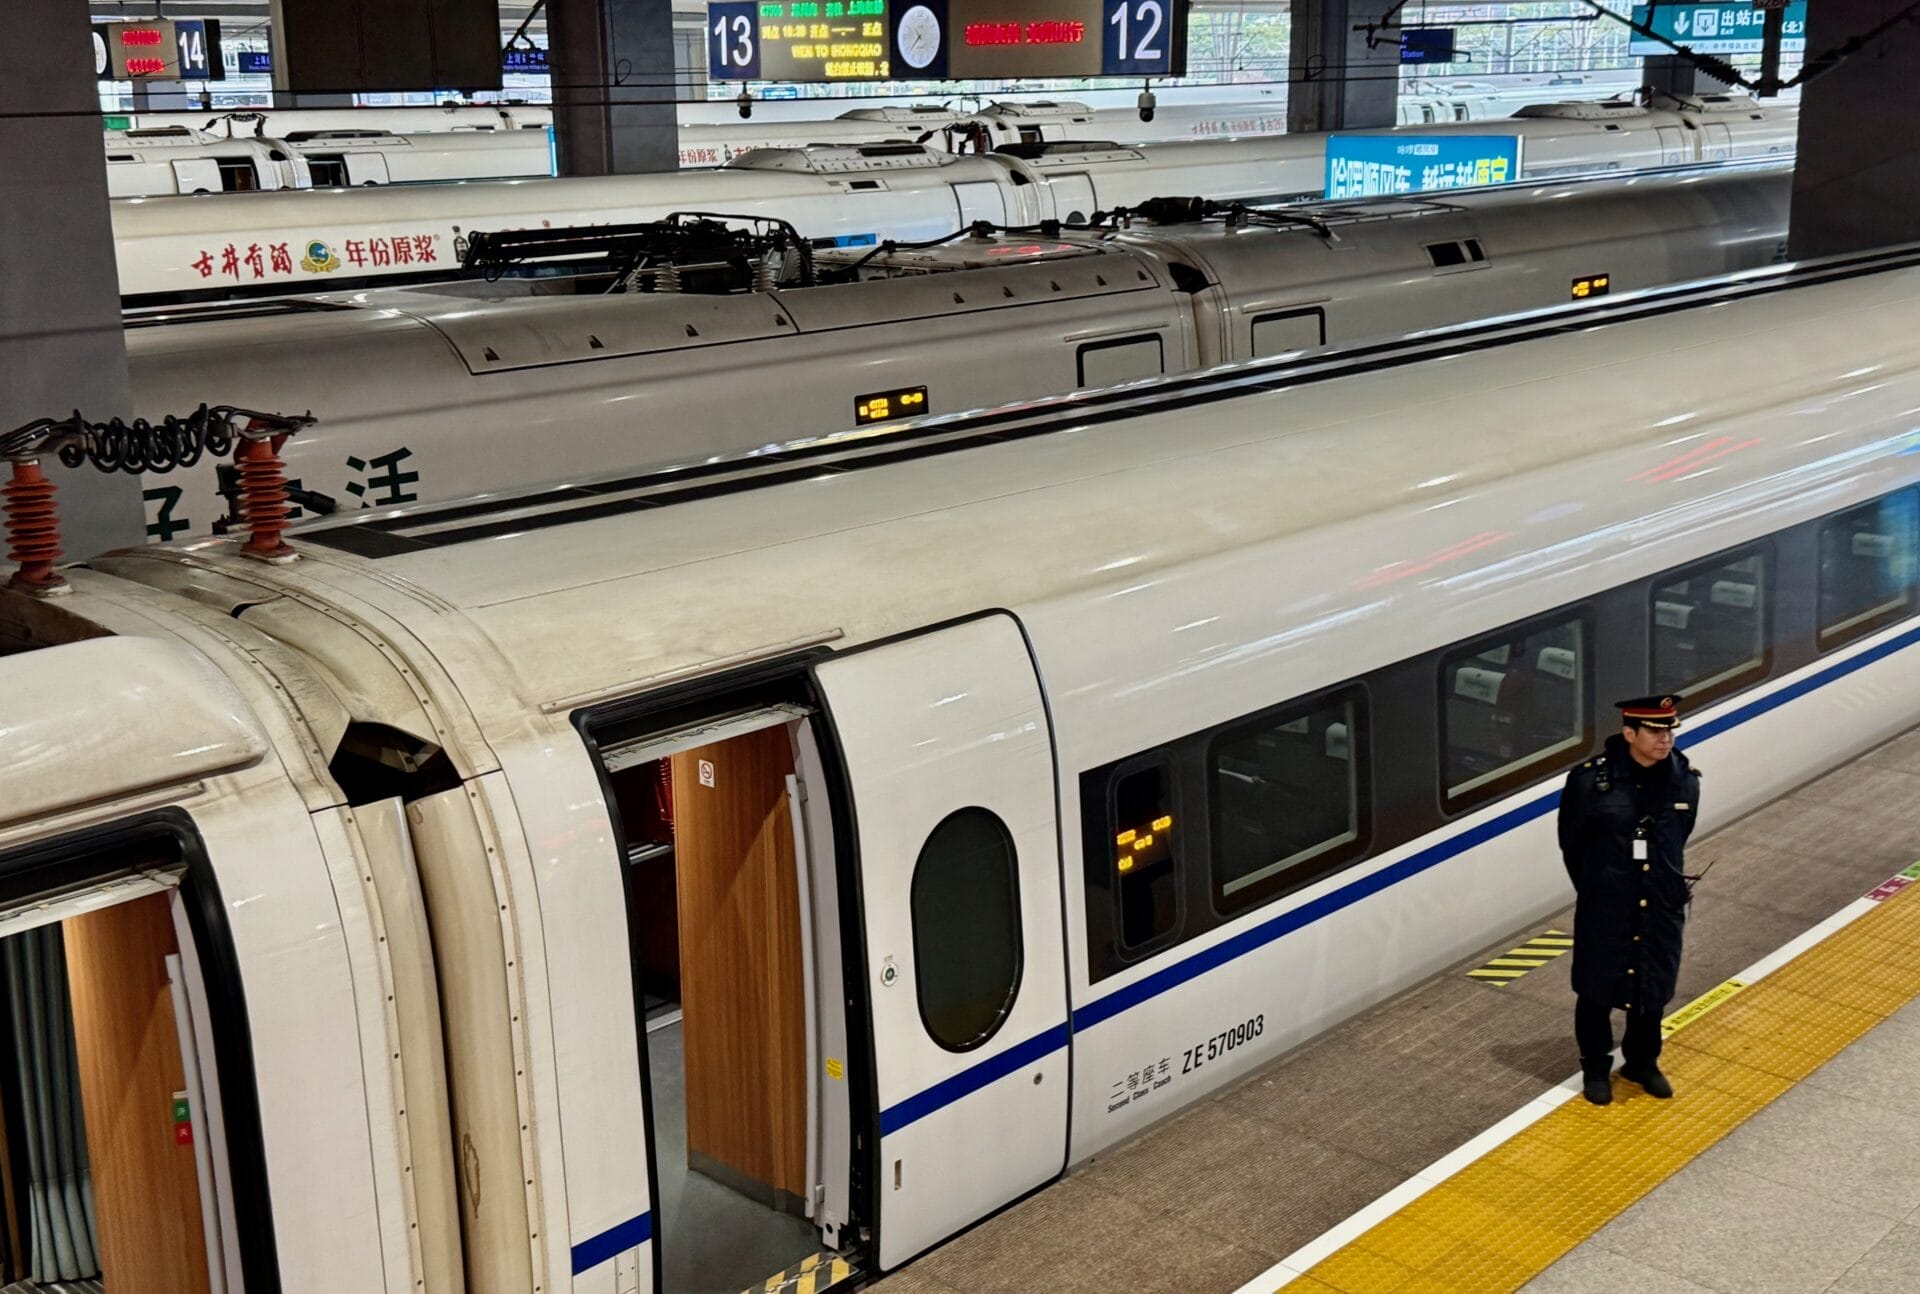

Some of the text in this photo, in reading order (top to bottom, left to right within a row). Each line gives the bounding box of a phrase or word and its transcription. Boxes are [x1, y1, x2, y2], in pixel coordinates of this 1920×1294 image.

[714, 15, 753, 66] 13
[1111, 1, 1163, 60] 12
[1720, 10, 1766, 27] 出站口
[179, 31, 204, 70] 14
[191, 235, 437, 282] 古井贡酒 年份原浆
[1182, 1014, 1265, 1075] ZE 570903
[1107, 1075, 1172, 1113] Second Class Coach
[1110, 1057, 1171, 1099] 二等座车
